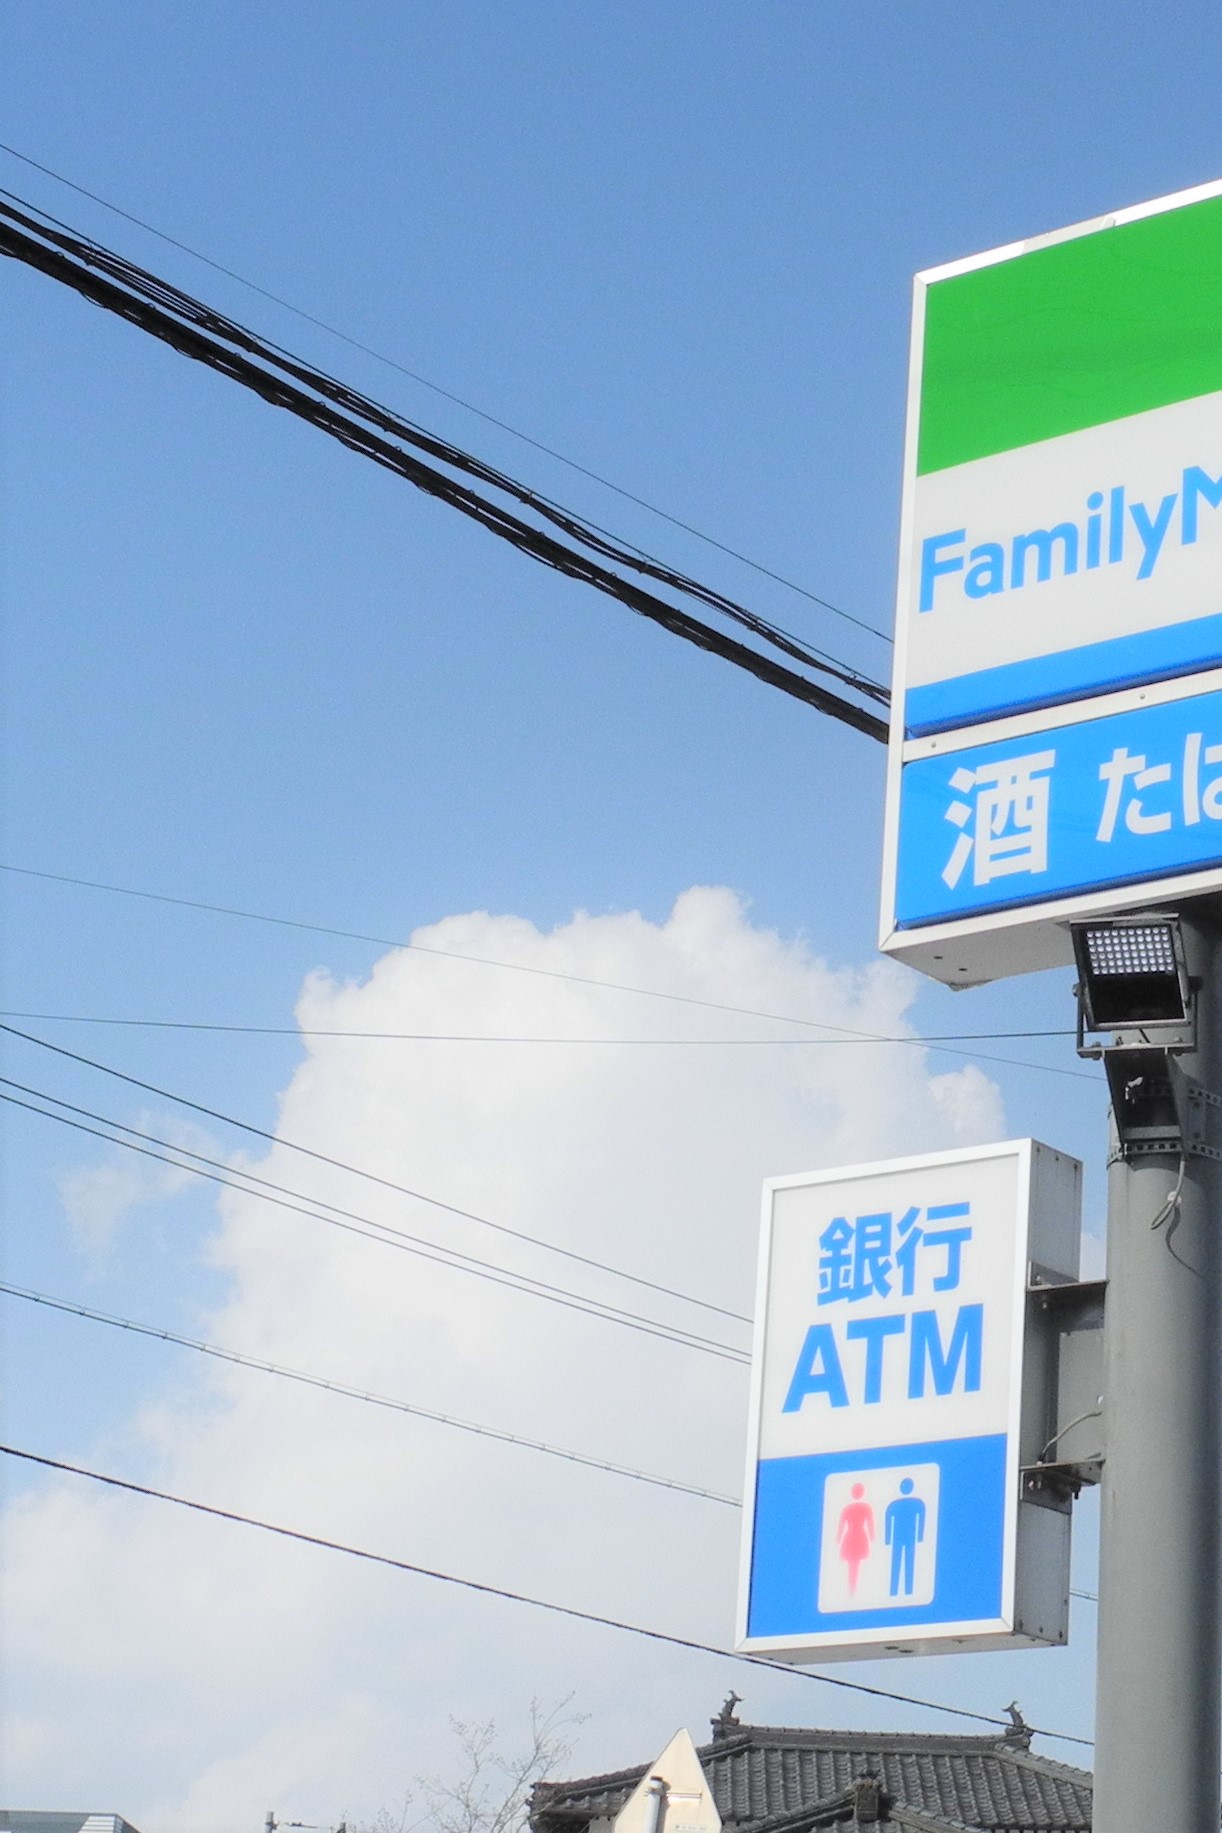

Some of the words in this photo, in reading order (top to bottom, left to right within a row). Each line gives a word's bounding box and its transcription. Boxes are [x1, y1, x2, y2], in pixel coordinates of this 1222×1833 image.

[941, 749, 1056, 890] 酒
[816, 1201, 973, 1307] 銀行
[781, 1302, 984, 1414] ATM
